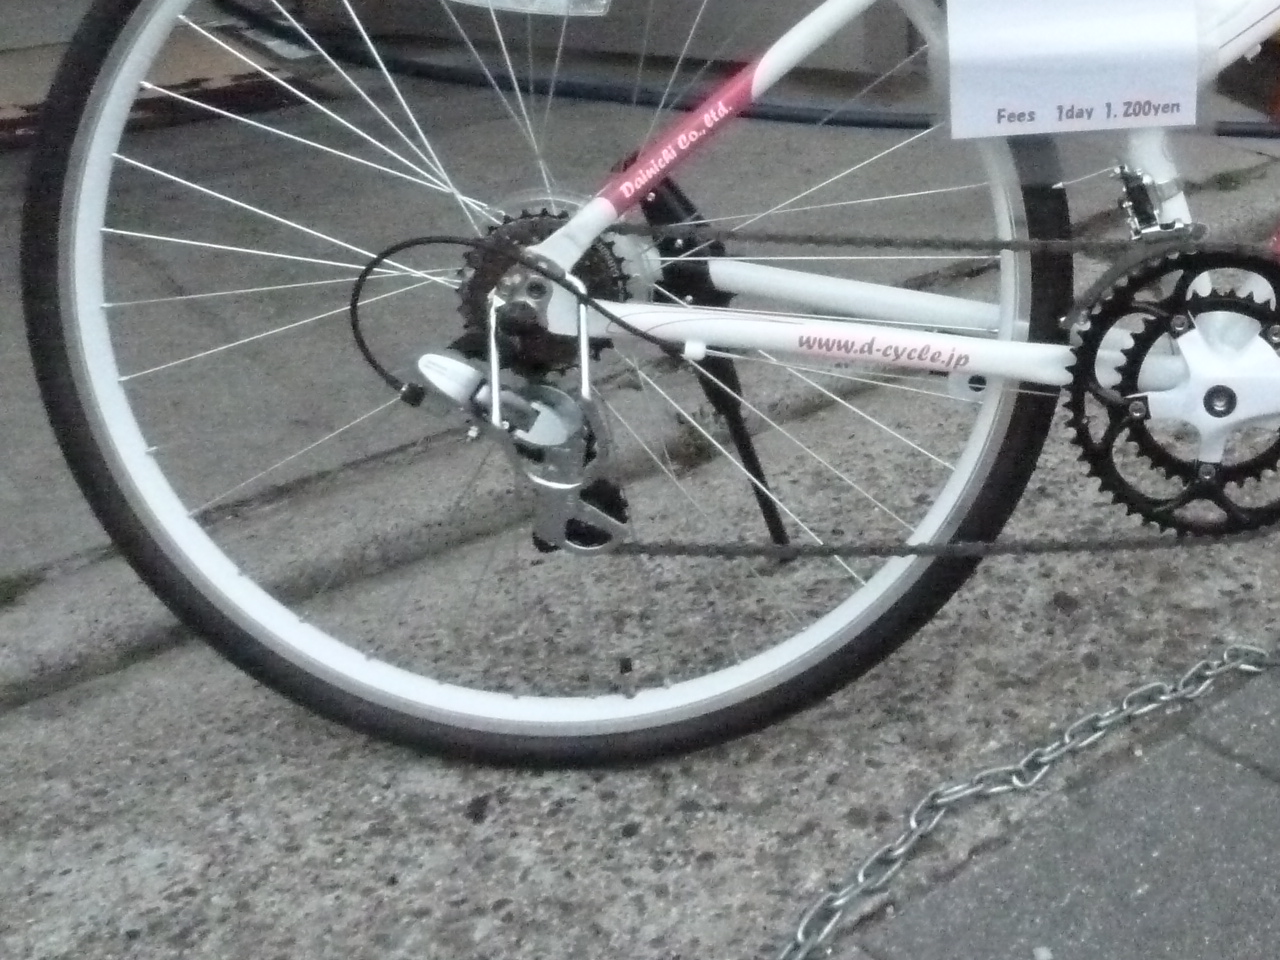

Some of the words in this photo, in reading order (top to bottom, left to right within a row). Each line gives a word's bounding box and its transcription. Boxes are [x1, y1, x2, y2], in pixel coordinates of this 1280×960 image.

[996, 108, 1036, 124] Fees
[1056, 104, 1094, 122] 1day
[619, 145, 678, 199] Dainichi
[797, 334, 971, 370] www.d-cycle.jp
